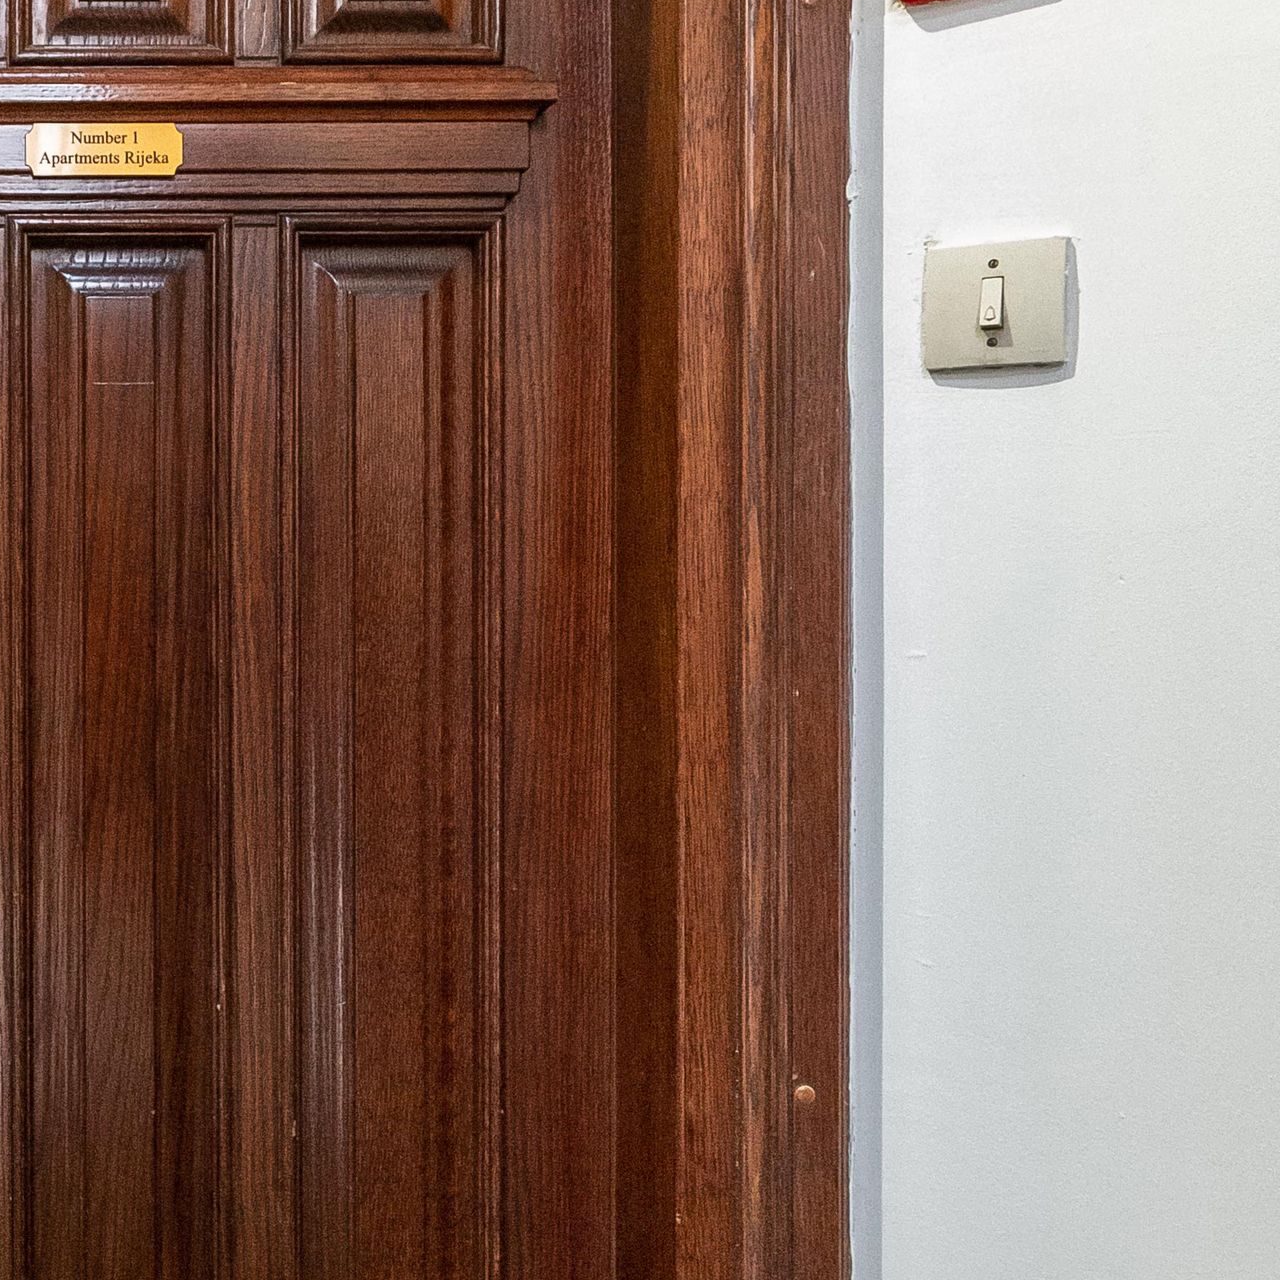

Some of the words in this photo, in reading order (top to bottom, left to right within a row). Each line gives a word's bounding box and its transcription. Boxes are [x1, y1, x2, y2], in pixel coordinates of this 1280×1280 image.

[71, 131, 127, 144] Number
[133, 131, 138, 144] 1
[39, 152, 120, 167] Apartments
[124, 151, 169, 168] Rijeka
